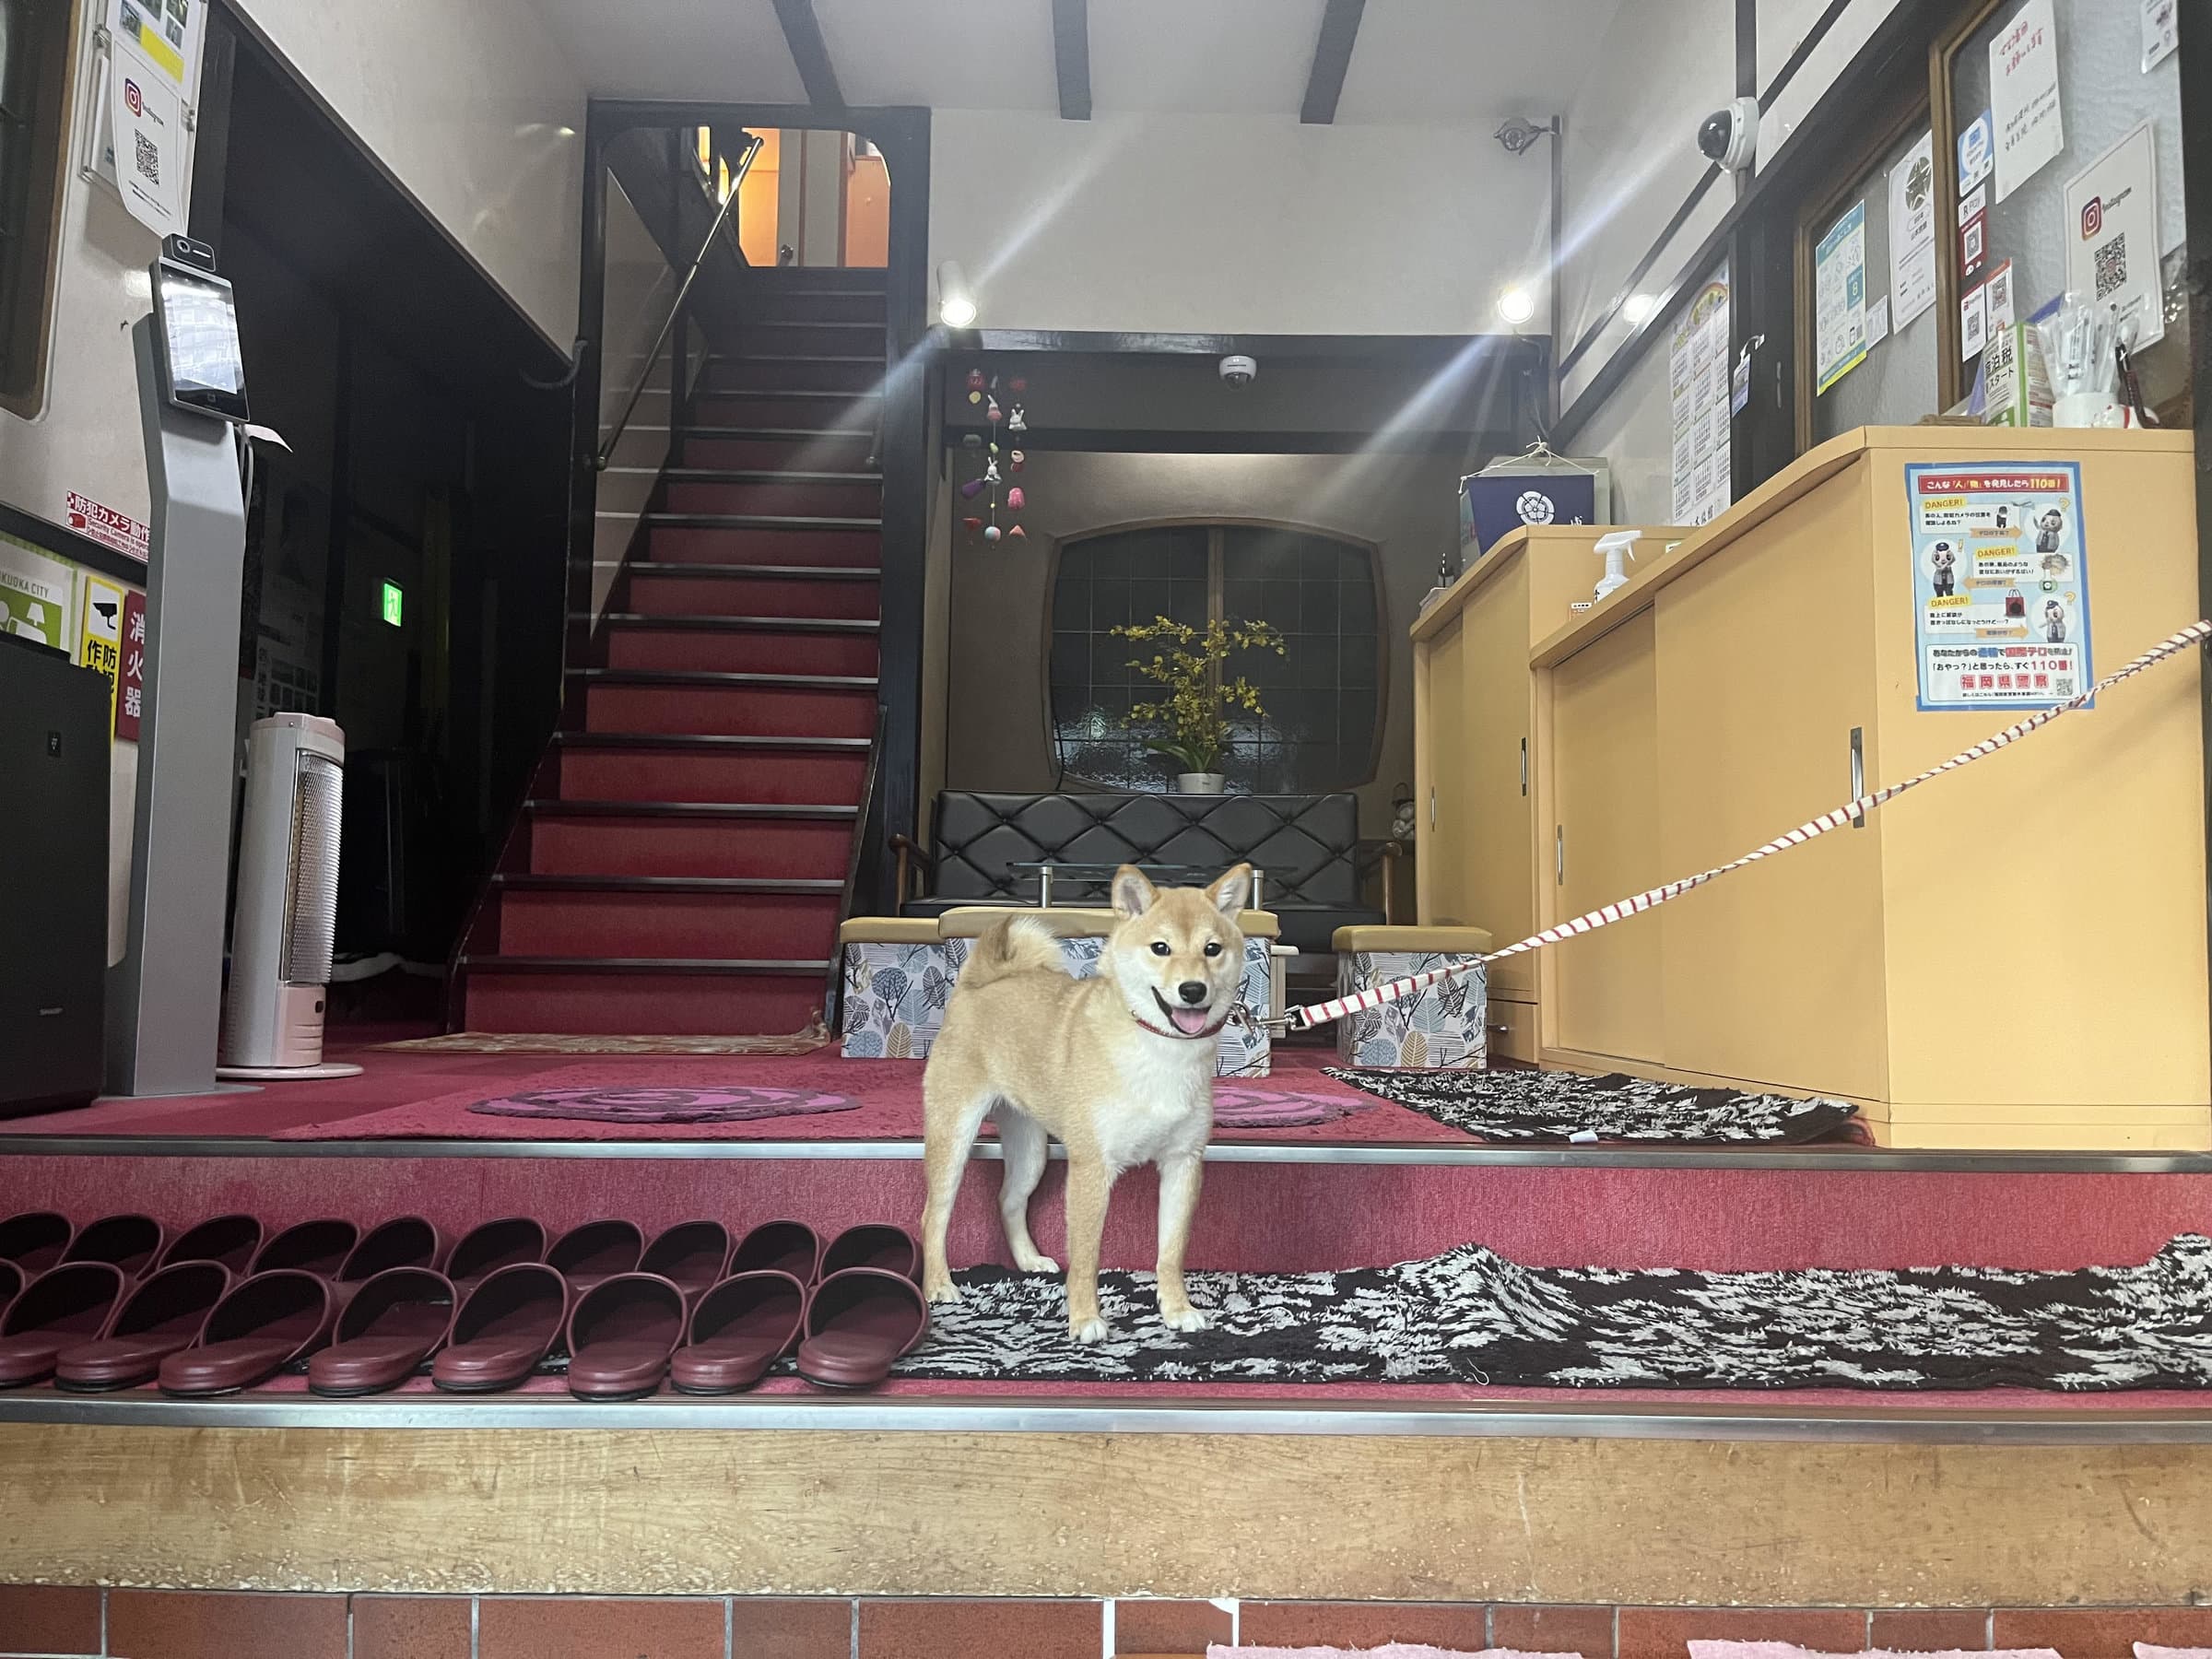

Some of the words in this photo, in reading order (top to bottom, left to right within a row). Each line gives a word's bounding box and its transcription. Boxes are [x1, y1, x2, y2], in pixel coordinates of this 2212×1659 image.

[1924, 499, 1963, 510] DANGER!
[1977, 547, 2016, 558] DANGER!
[0, 571, 29, 594] KUOKA
[31, 582, 50, 598] CITY
[1931, 597, 1969, 607] DANGER!
[124, 611, 146, 718] 消火器
[1960, 674, 2049, 690] 福岡県警察
